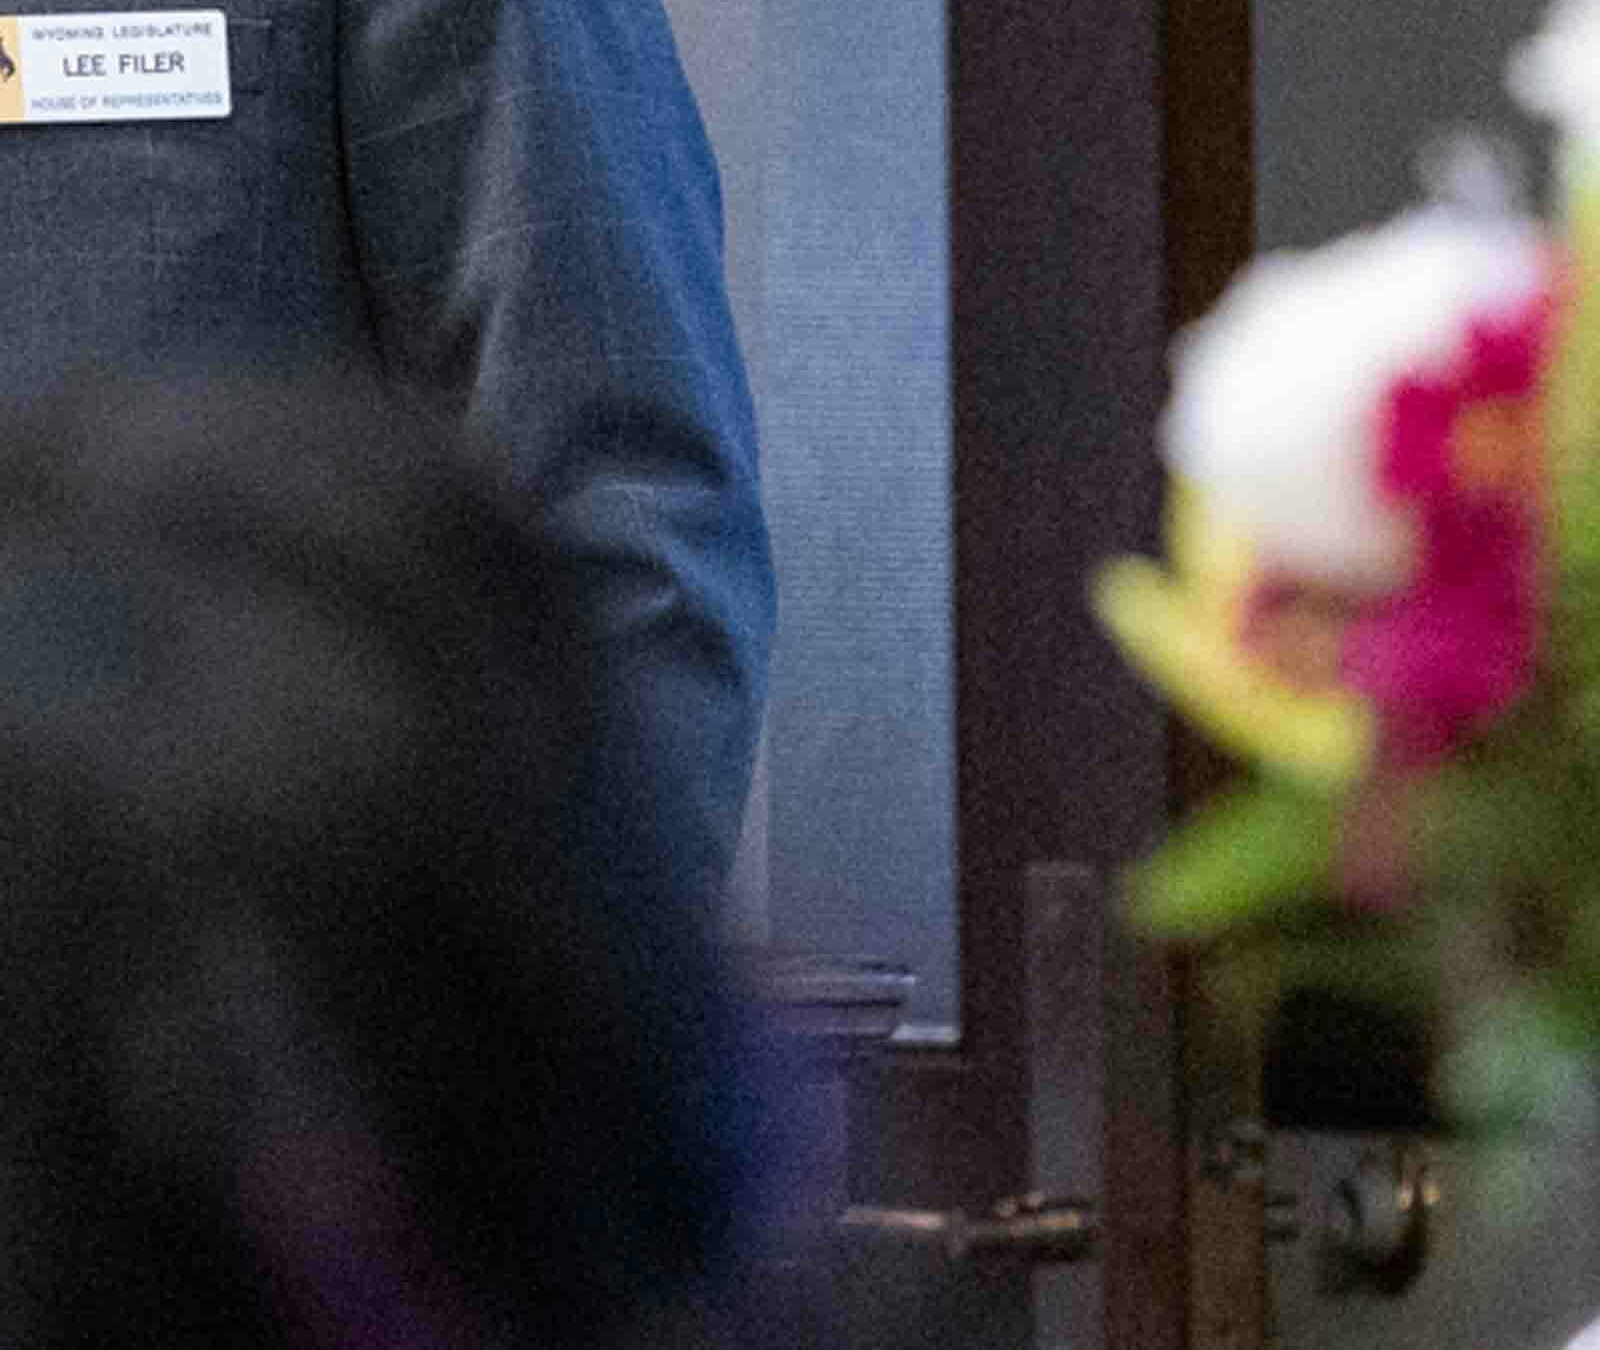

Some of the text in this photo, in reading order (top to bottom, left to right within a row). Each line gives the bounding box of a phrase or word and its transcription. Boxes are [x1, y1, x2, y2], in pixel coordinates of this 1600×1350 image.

[113, 22, 212, 39] LEGISLATURE
[62, 51, 185, 77] LEE FILER
